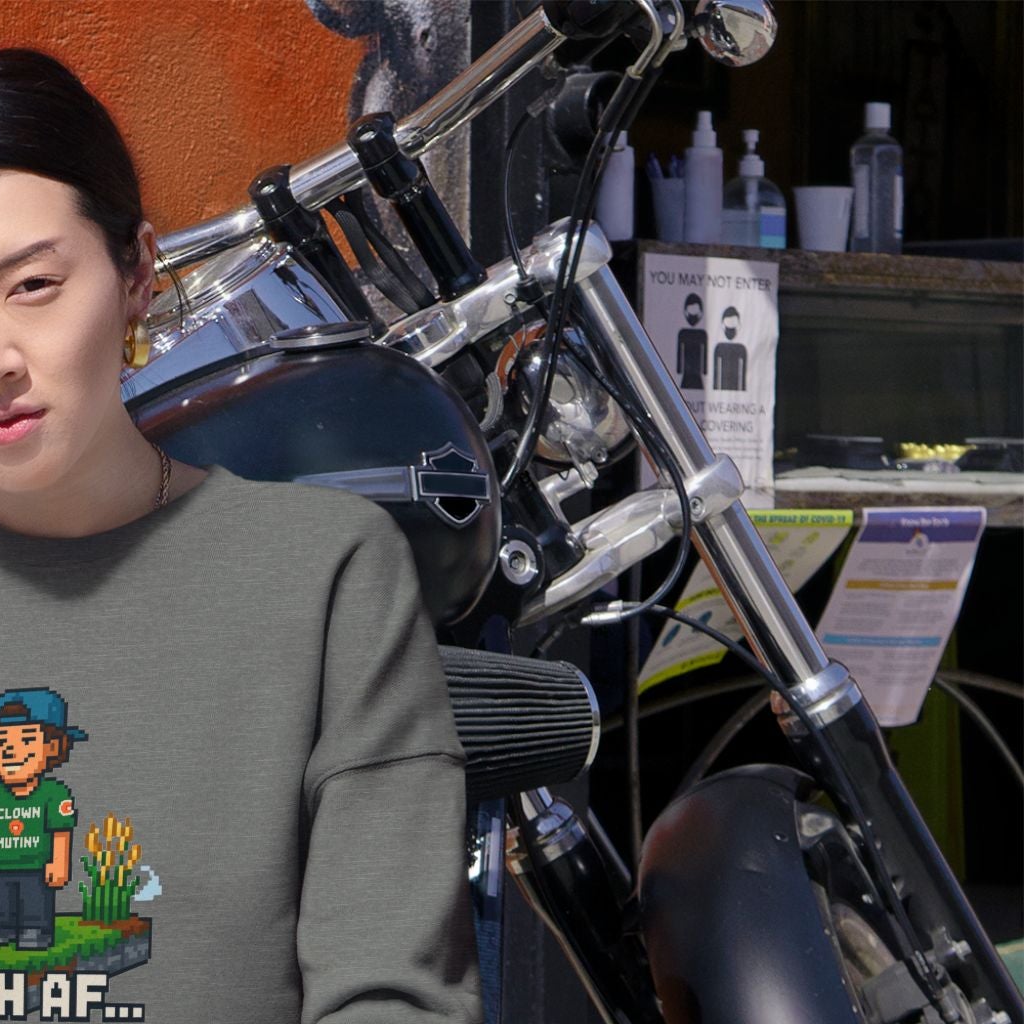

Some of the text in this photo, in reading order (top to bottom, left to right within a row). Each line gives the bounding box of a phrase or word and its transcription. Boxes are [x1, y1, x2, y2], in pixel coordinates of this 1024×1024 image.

[650, 271, 771, 291] YOU MAY NOT ENTER
[709, 403, 756, 415] WEARING
[759, 404, 767, 415] A
[701, 420, 754, 433] COVERING
[40, 972, 145, 1020] AF...
